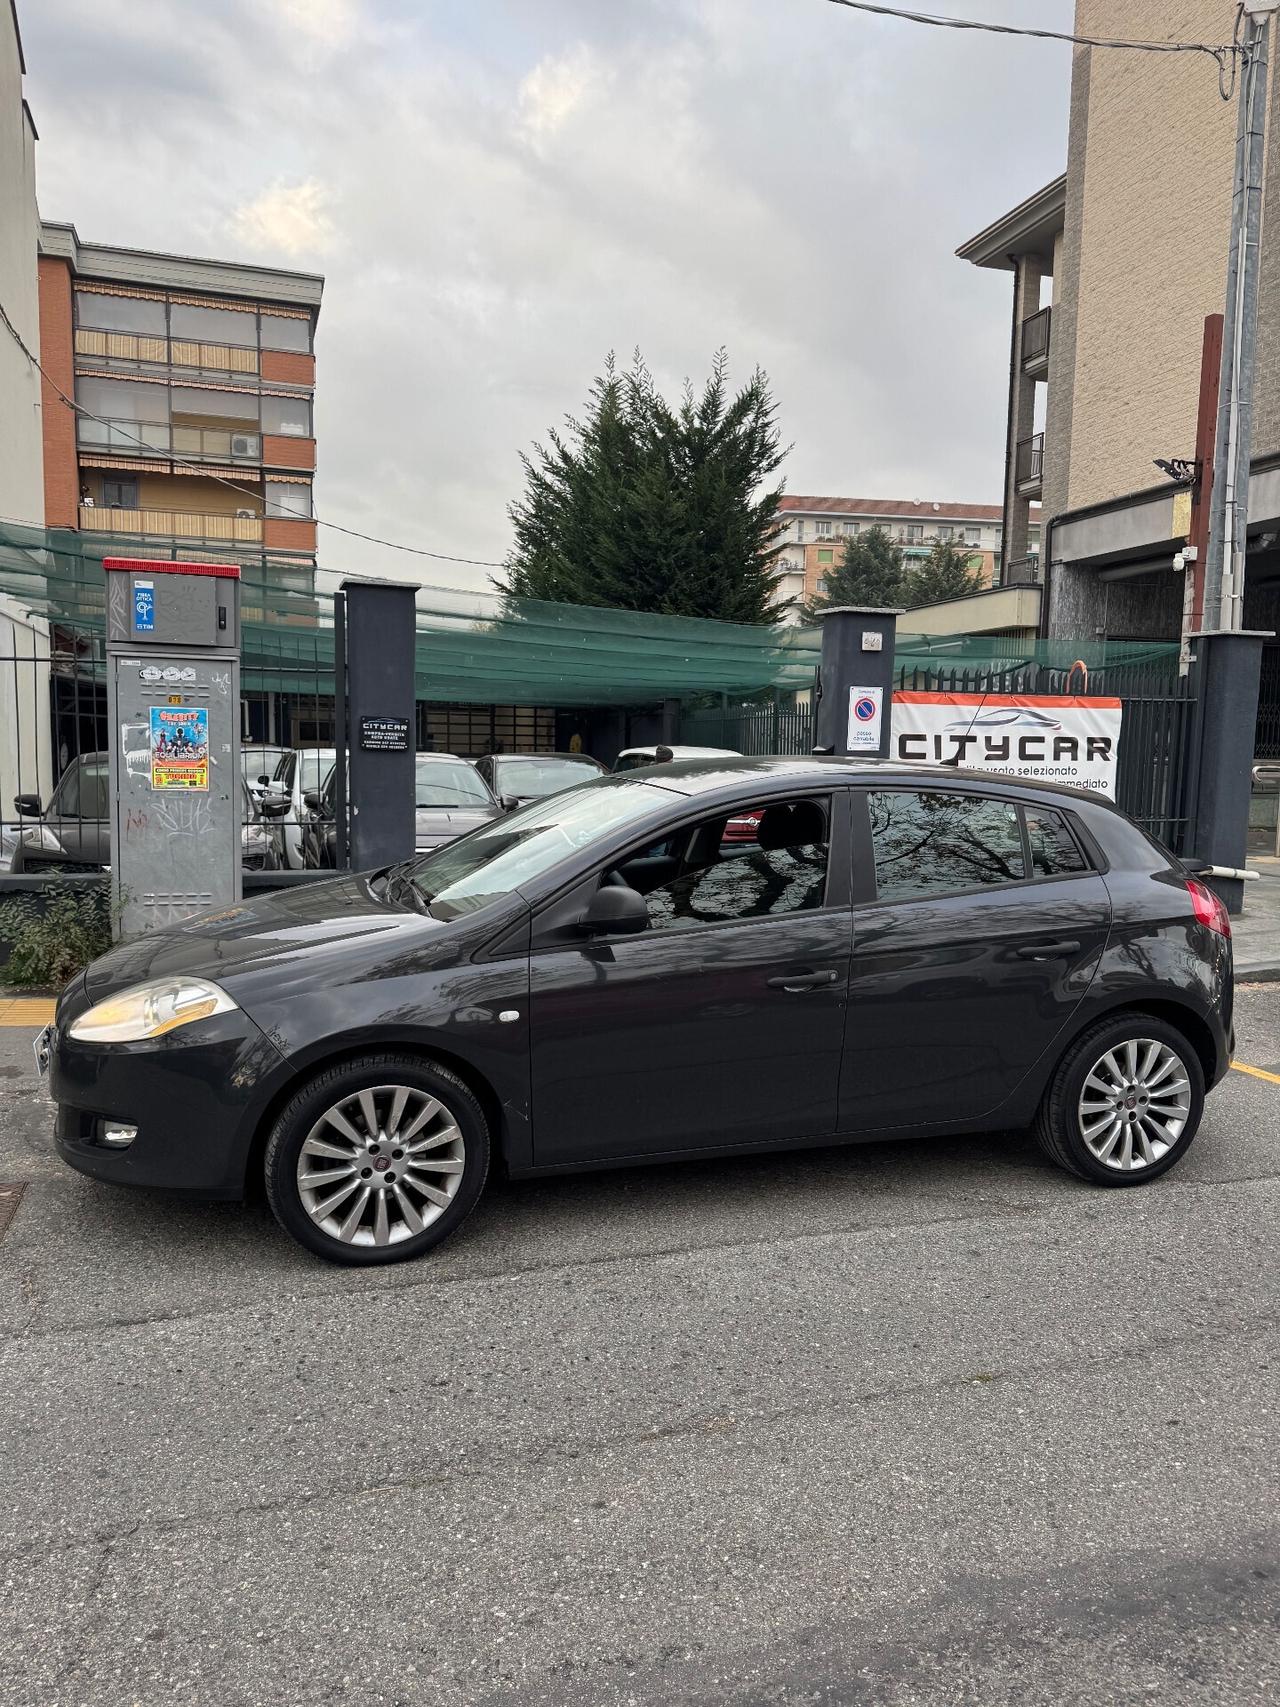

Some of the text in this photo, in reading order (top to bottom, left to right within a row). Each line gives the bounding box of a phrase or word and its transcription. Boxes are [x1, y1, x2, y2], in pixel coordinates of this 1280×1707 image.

[362, 723, 408, 731] CITYCAR
[898, 733, 1113, 762] CITYCAR
[1017, 765, 1078, 776] selezionato
